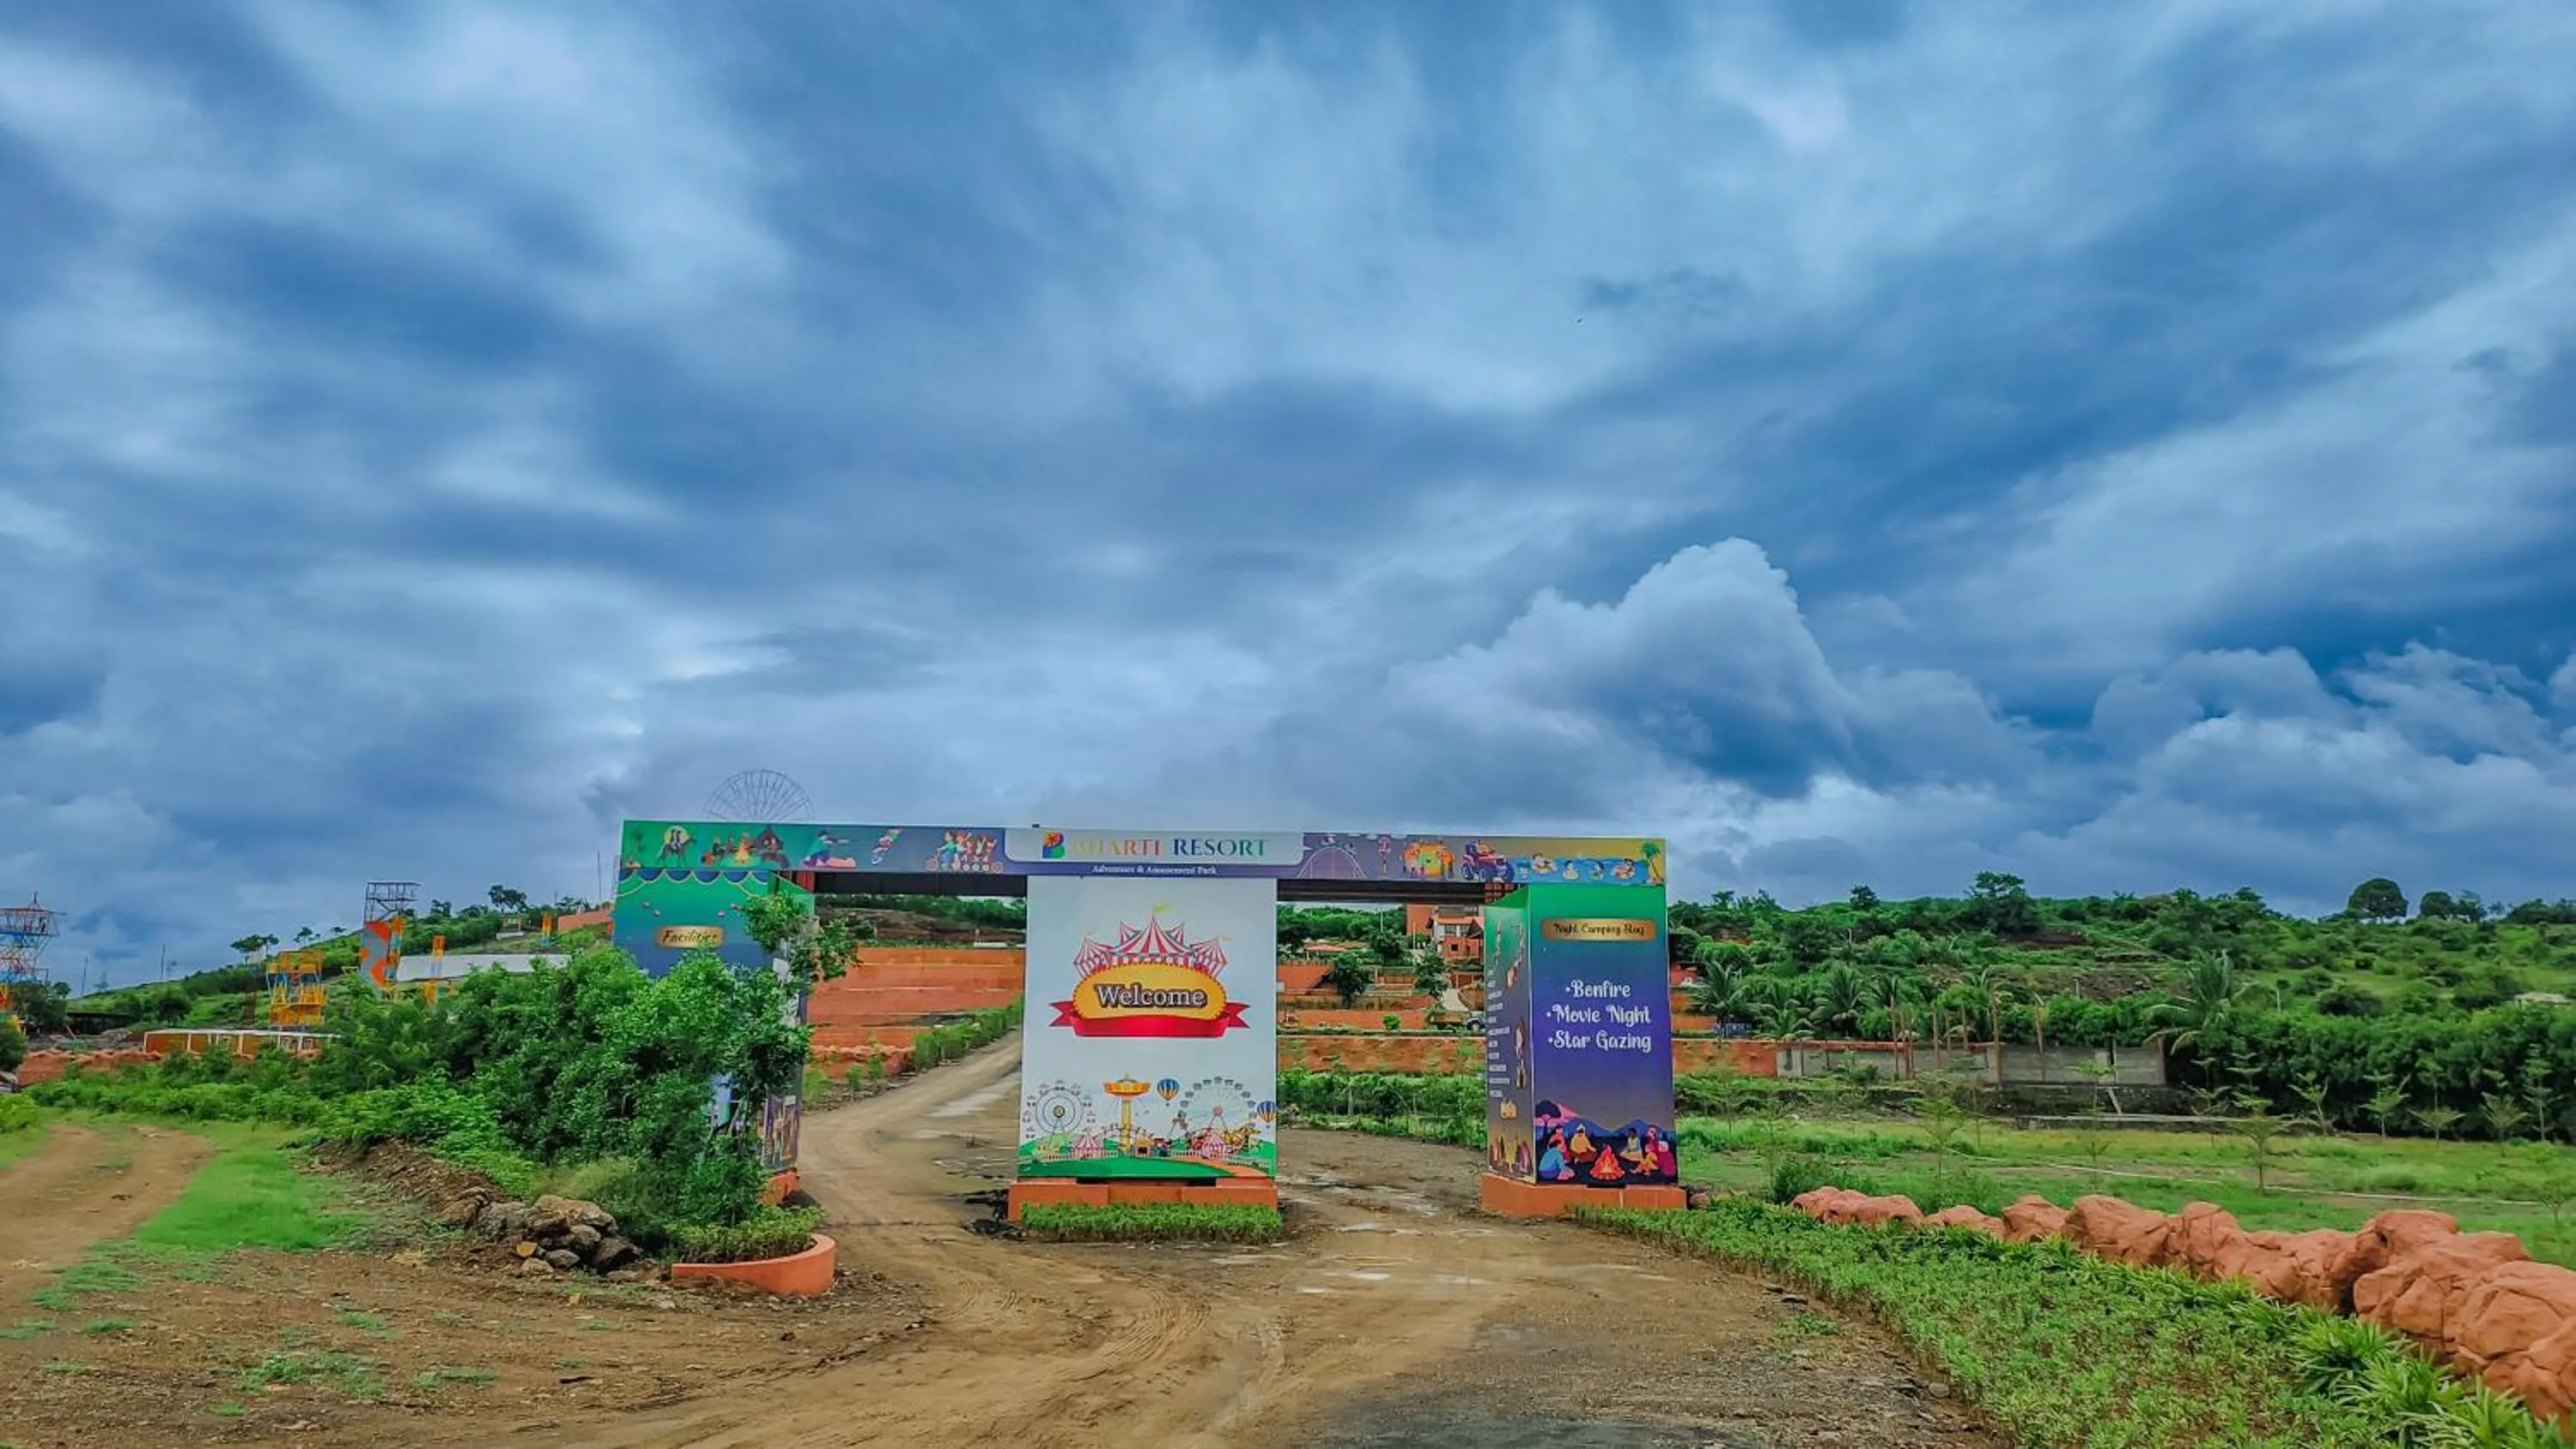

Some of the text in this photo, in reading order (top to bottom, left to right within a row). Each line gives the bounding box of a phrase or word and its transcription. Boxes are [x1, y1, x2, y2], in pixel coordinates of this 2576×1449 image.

[1174, 838, 1267, 857] RESORT
[1552, 923, 1577, 935] Night
[1095, 983, 1208, 1008] Welcome
[1606, 1003, 1651, 1028] Night
[1595, 1029, 1651, 1053] Gazing
